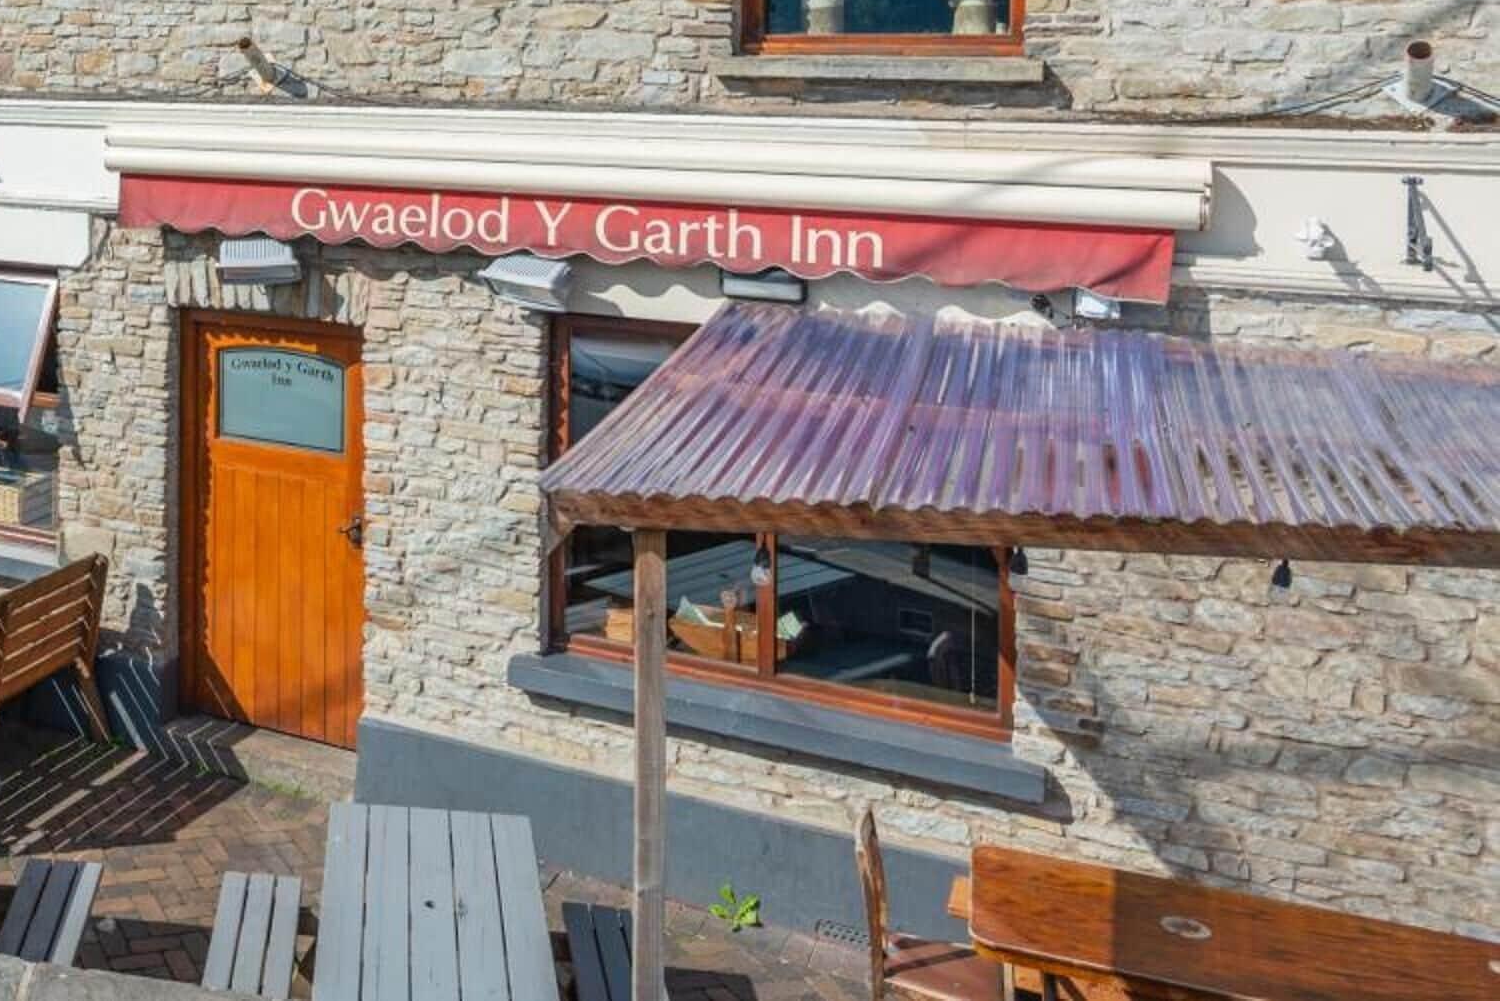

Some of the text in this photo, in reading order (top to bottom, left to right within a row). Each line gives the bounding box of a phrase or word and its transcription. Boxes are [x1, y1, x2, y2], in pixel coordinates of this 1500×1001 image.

[291, 188, 884, 269] Gwaelod Y Garth Inn
